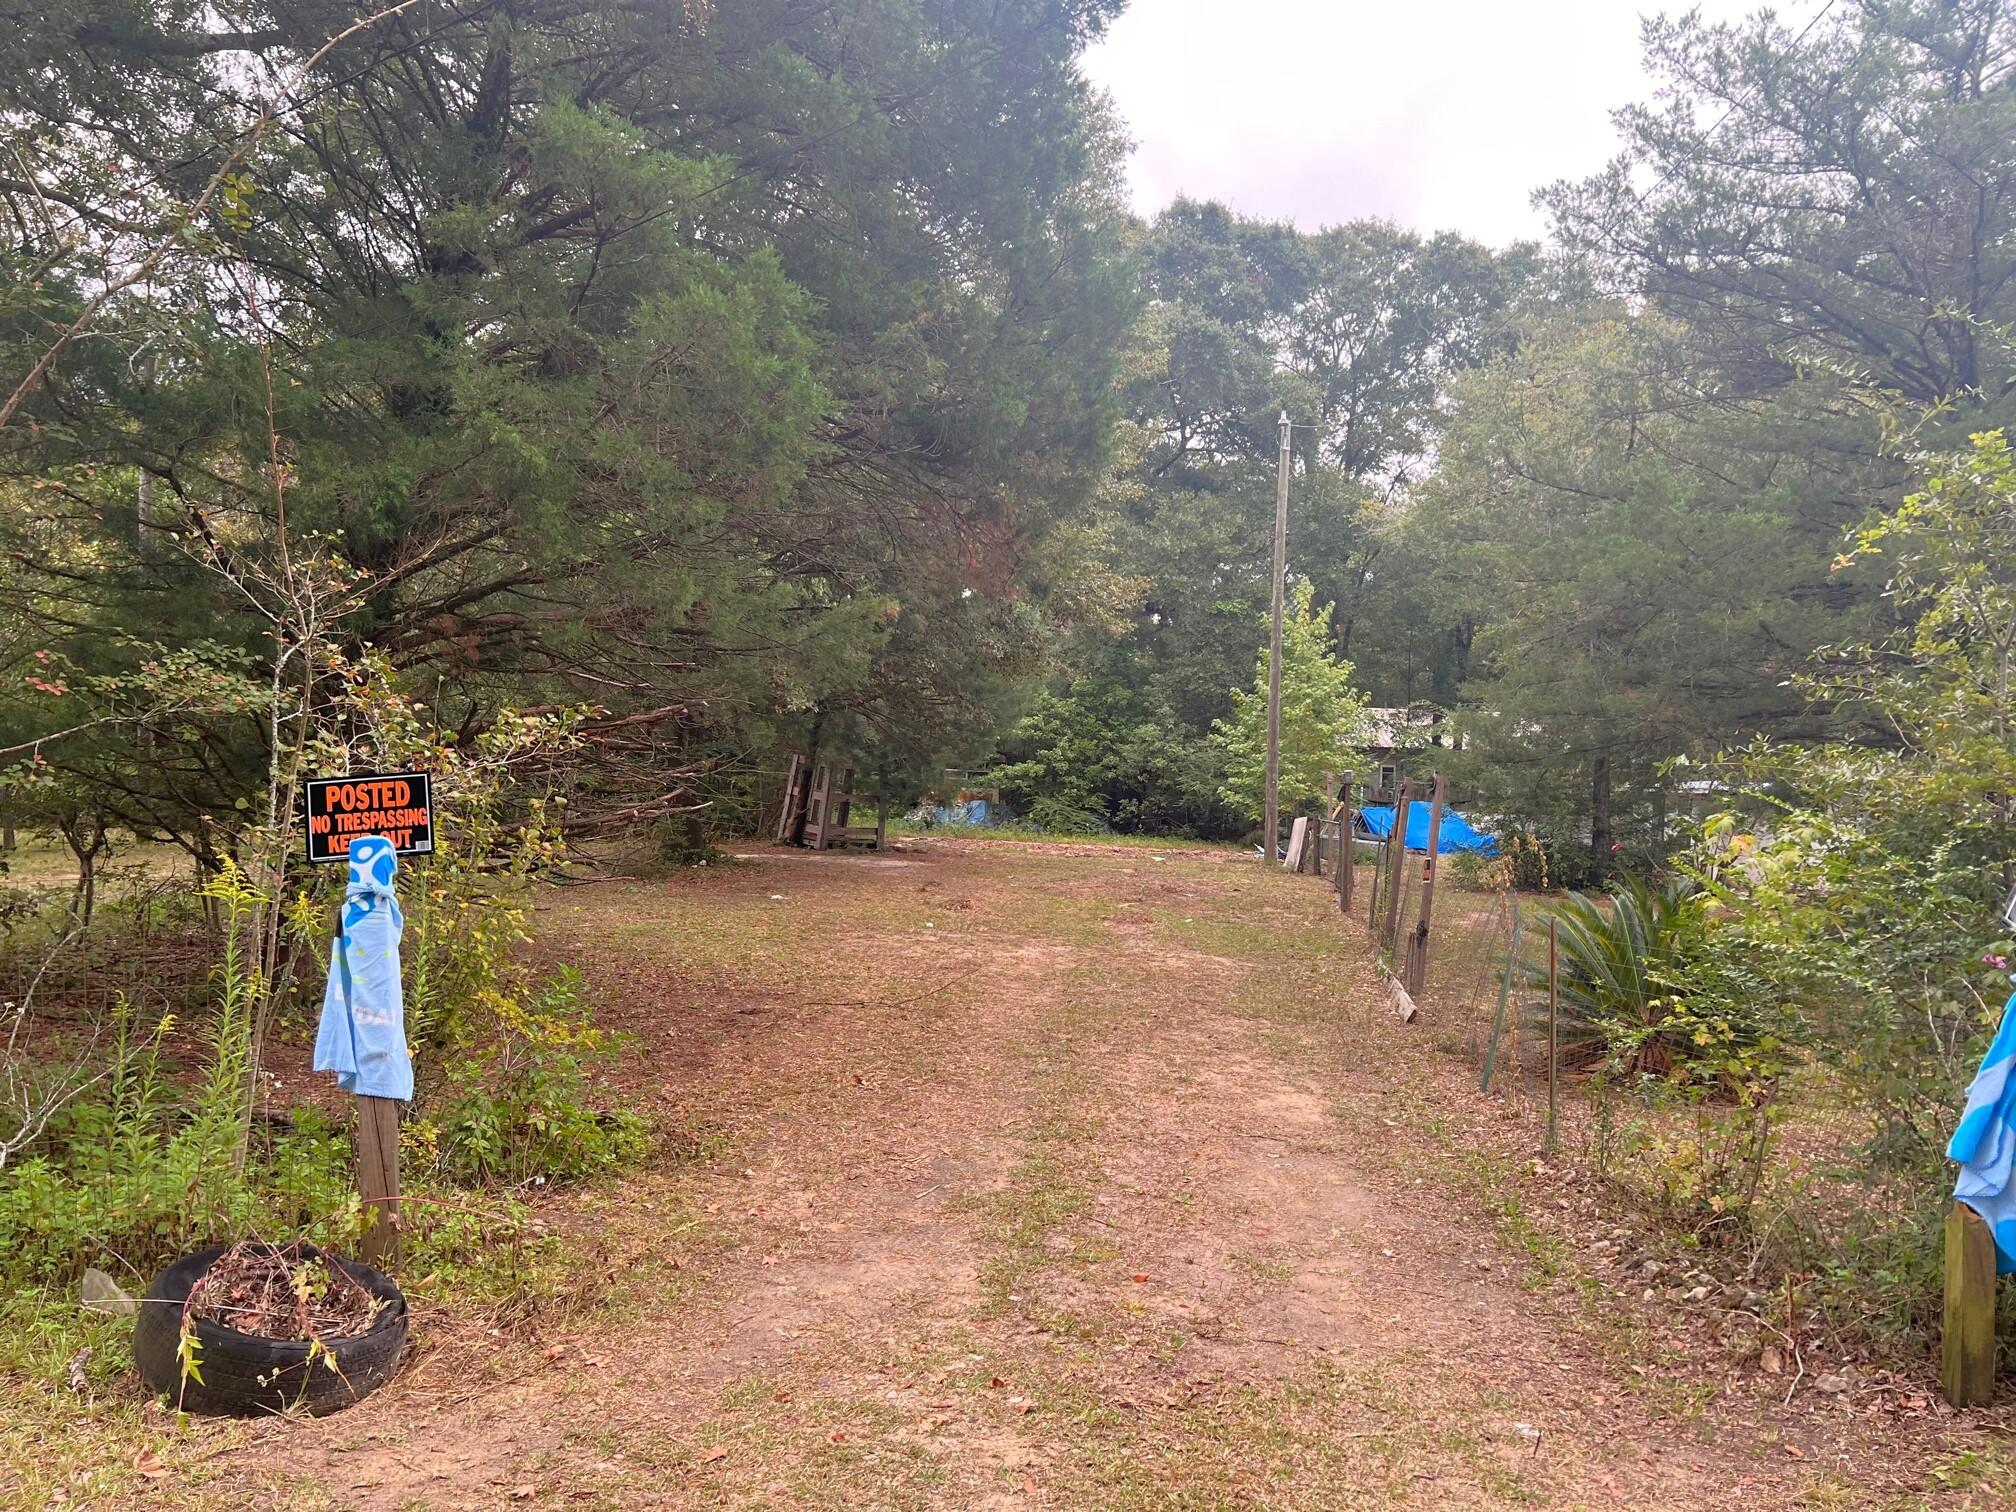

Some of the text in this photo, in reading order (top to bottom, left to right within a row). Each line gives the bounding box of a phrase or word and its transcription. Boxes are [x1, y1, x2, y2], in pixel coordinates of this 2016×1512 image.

[326, 780, 410, 812] POSTED
[311, 808, 428, 834] NO TRESPASSING
